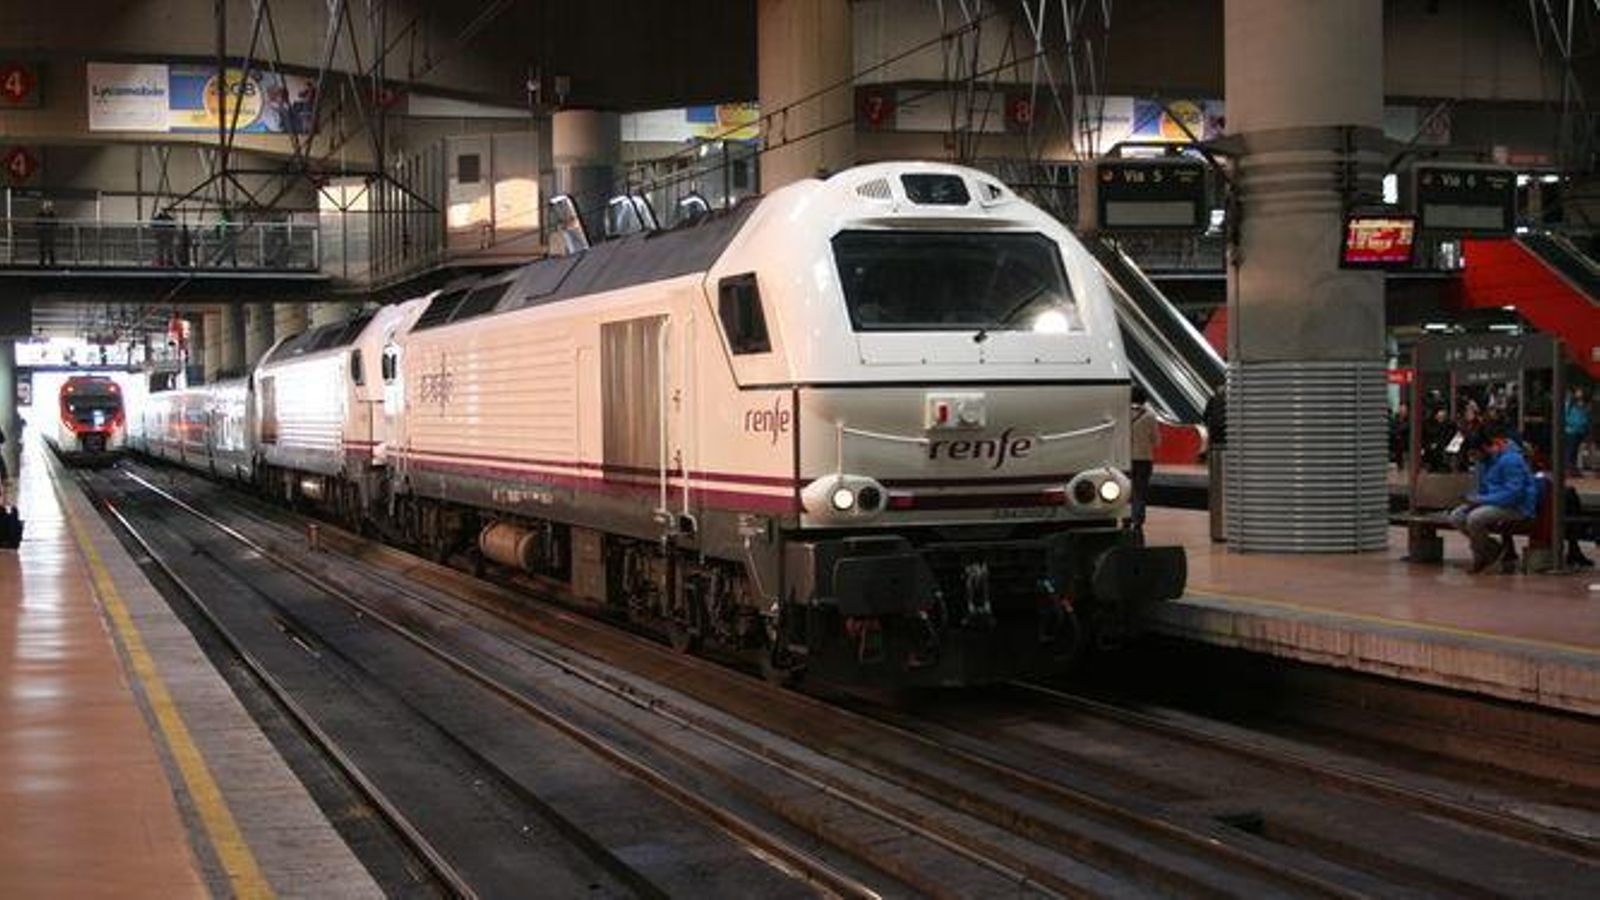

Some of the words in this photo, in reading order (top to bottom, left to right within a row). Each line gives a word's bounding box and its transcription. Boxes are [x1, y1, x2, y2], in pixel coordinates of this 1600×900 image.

[6, 71, 22, 97] 4
[12, 152, 26, 176] 4
[744, 394, 791, 445] renfe
[928, 427, 1032, 470] renfe
